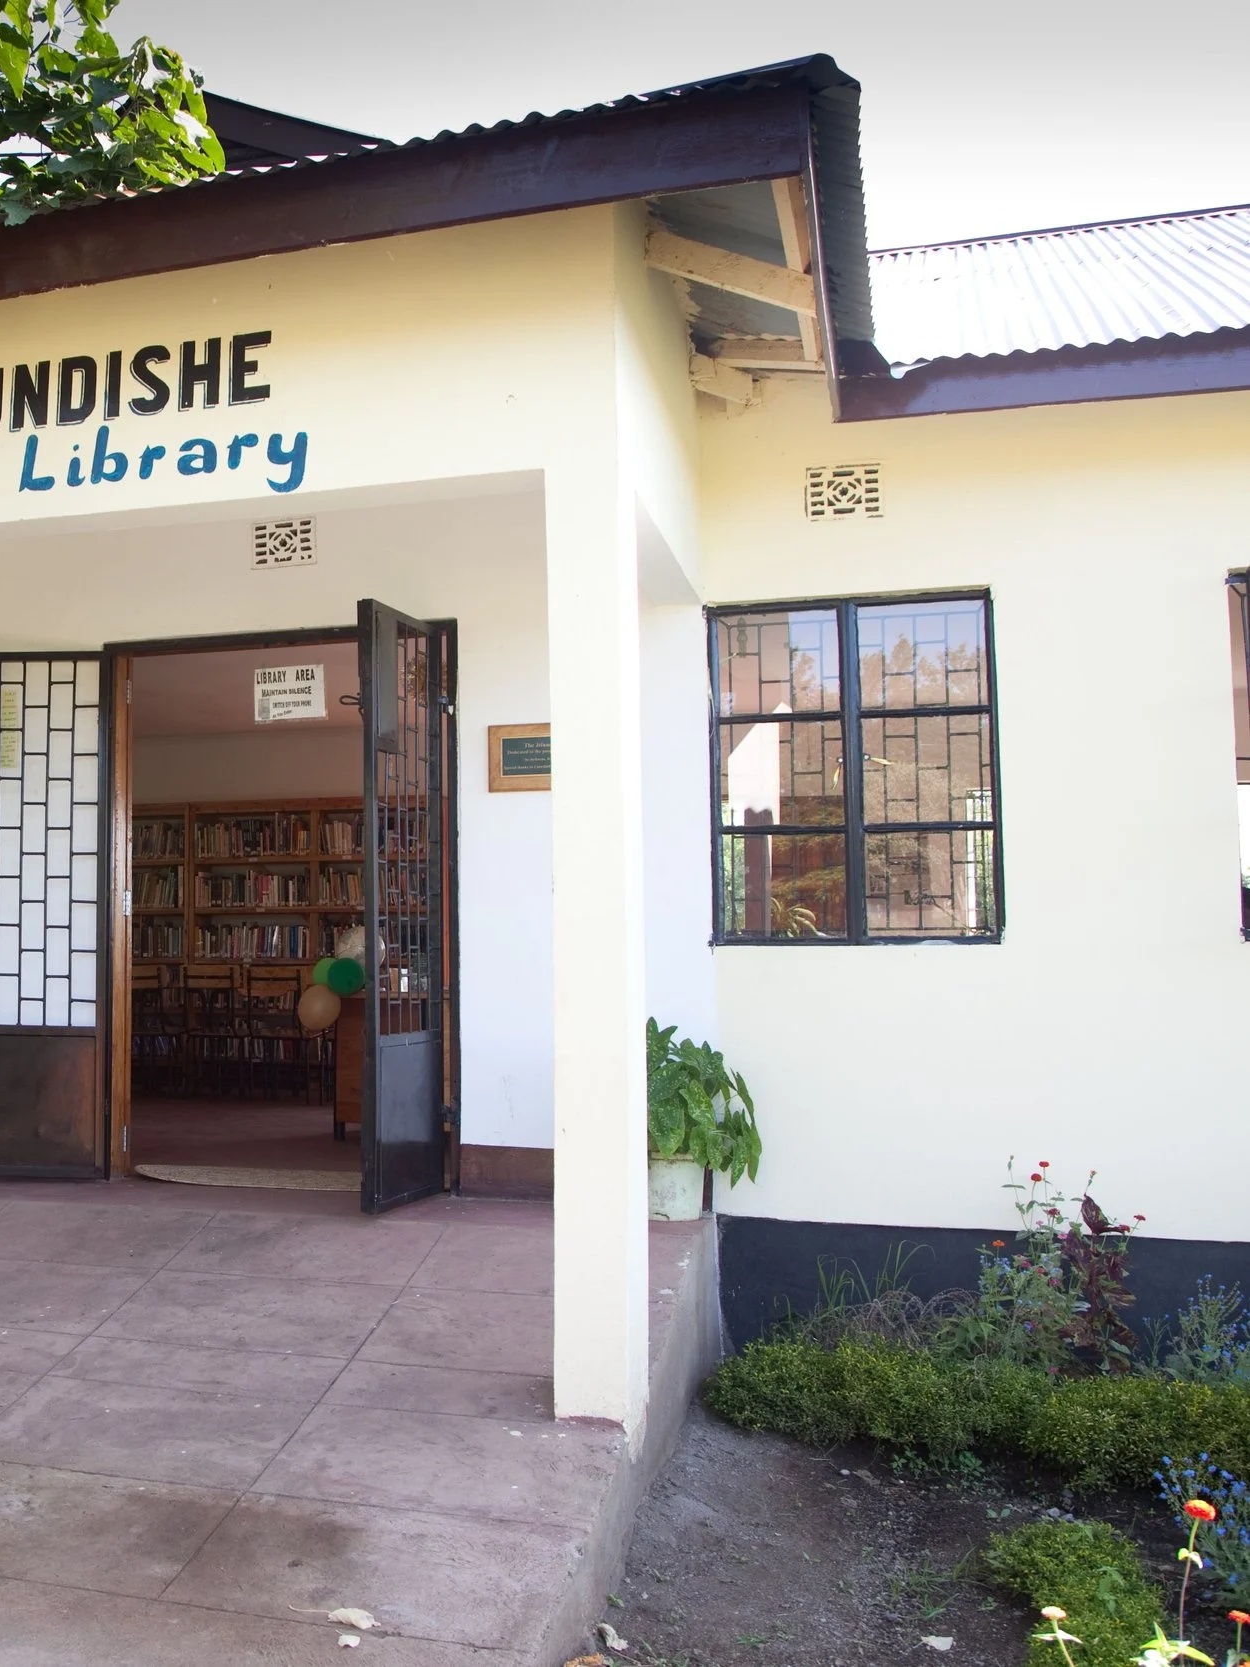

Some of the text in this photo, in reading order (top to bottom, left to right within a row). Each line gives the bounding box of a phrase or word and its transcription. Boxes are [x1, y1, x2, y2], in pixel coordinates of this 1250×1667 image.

[19, 426, 308, 492] Library
[256, 668, 315, 684] LIBRARY AREA
[262, 689, 288, 697] MAINTAIN
